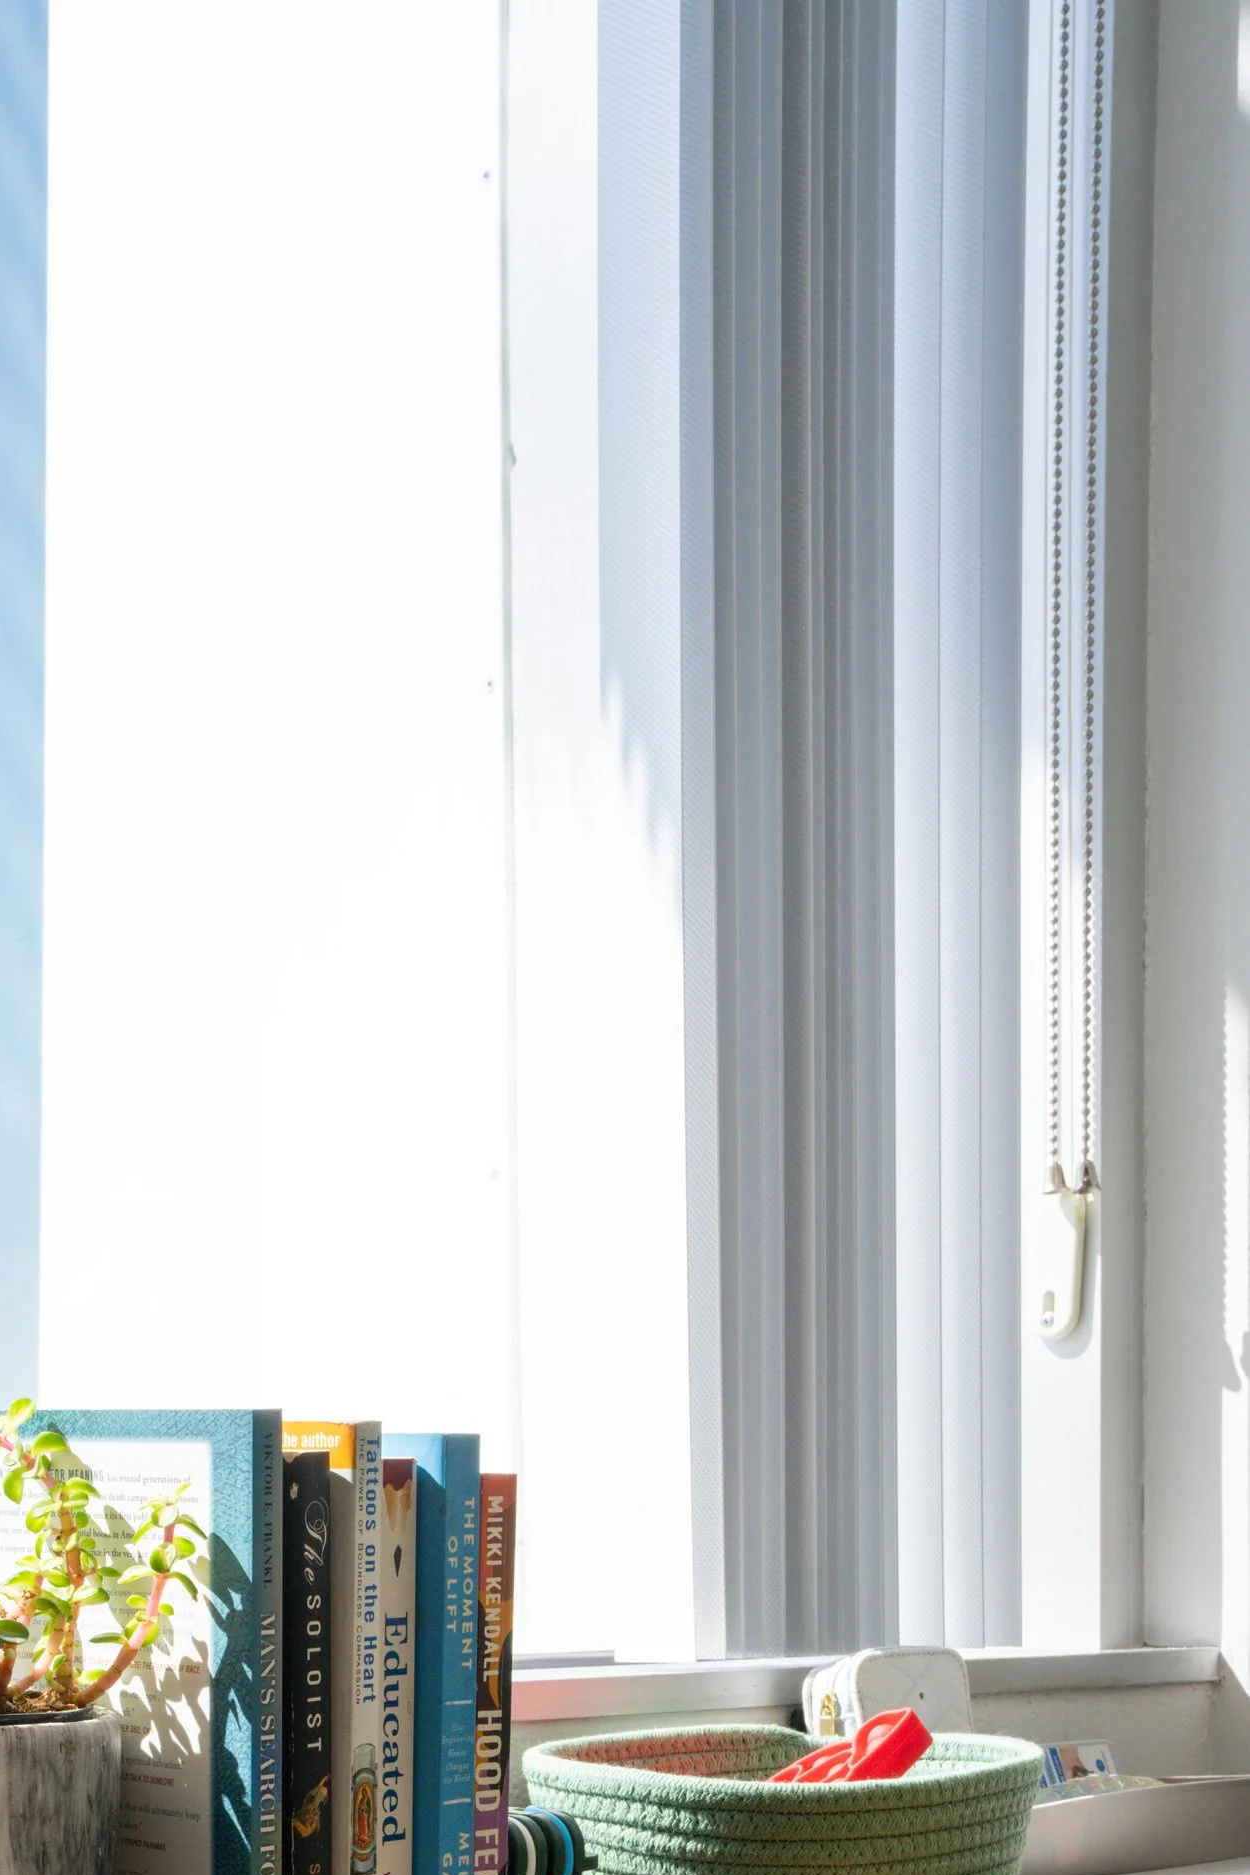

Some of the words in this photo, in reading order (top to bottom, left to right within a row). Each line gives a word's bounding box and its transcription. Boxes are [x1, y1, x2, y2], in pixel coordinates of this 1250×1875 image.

[263, 1432, 273, 1497] VIKTOR
[282, 1431, 297, 1448] he
[301, 1432, 340, 1448] author
[109, 1492, 126, 1501] death
[127, 1494, 147, 1504] camps
[143, 1475, 182, 1486] generations
[365, 1436, 379, 1531] Tattoos
[92, 1529, 111, 1538] books
[113, 1530, 120, 1538] in
[263, 1505, 273, 1517] E.
[358, 1519, 364, 1535] OF
[464, 1497, 475, 1546] THE
[486, 1496, 504, 1567] MIKKI
[111, 1549, 122, 1557] the
[263, 1522, 273, 1589] FRANKL
[304, 1497, 330, 1587] The
[365, 1544, 377, 1572] on
[448, 1535, 458, 1568] OF
[364, 1585, 378, 1623] the
[446, 1578, 457, 1633] LIFT
[461, 1556, 474, 1670] MOMENT
[483, 1576, 503, 1684] KENDALL
[186, 1665, 200, 1674] RACE
[260, 1614, 276, 1705] MAN'S
[306, 1594, 322, 1752] SOLOIST
[363, 1636, 377, 1703] Heart
[382, 1611, 408, 1847] Educated
[130, 1772, 141, 1783] TALK
[149, 1775, 174, 1787] SOMEONE
[260, 1716, 276, 1833] SEARCH
[475, 1709, 503, 1813] HOOD
[152, 1805, 183, 1818] ultimately
[185, 1808, 201, 1822] keep
